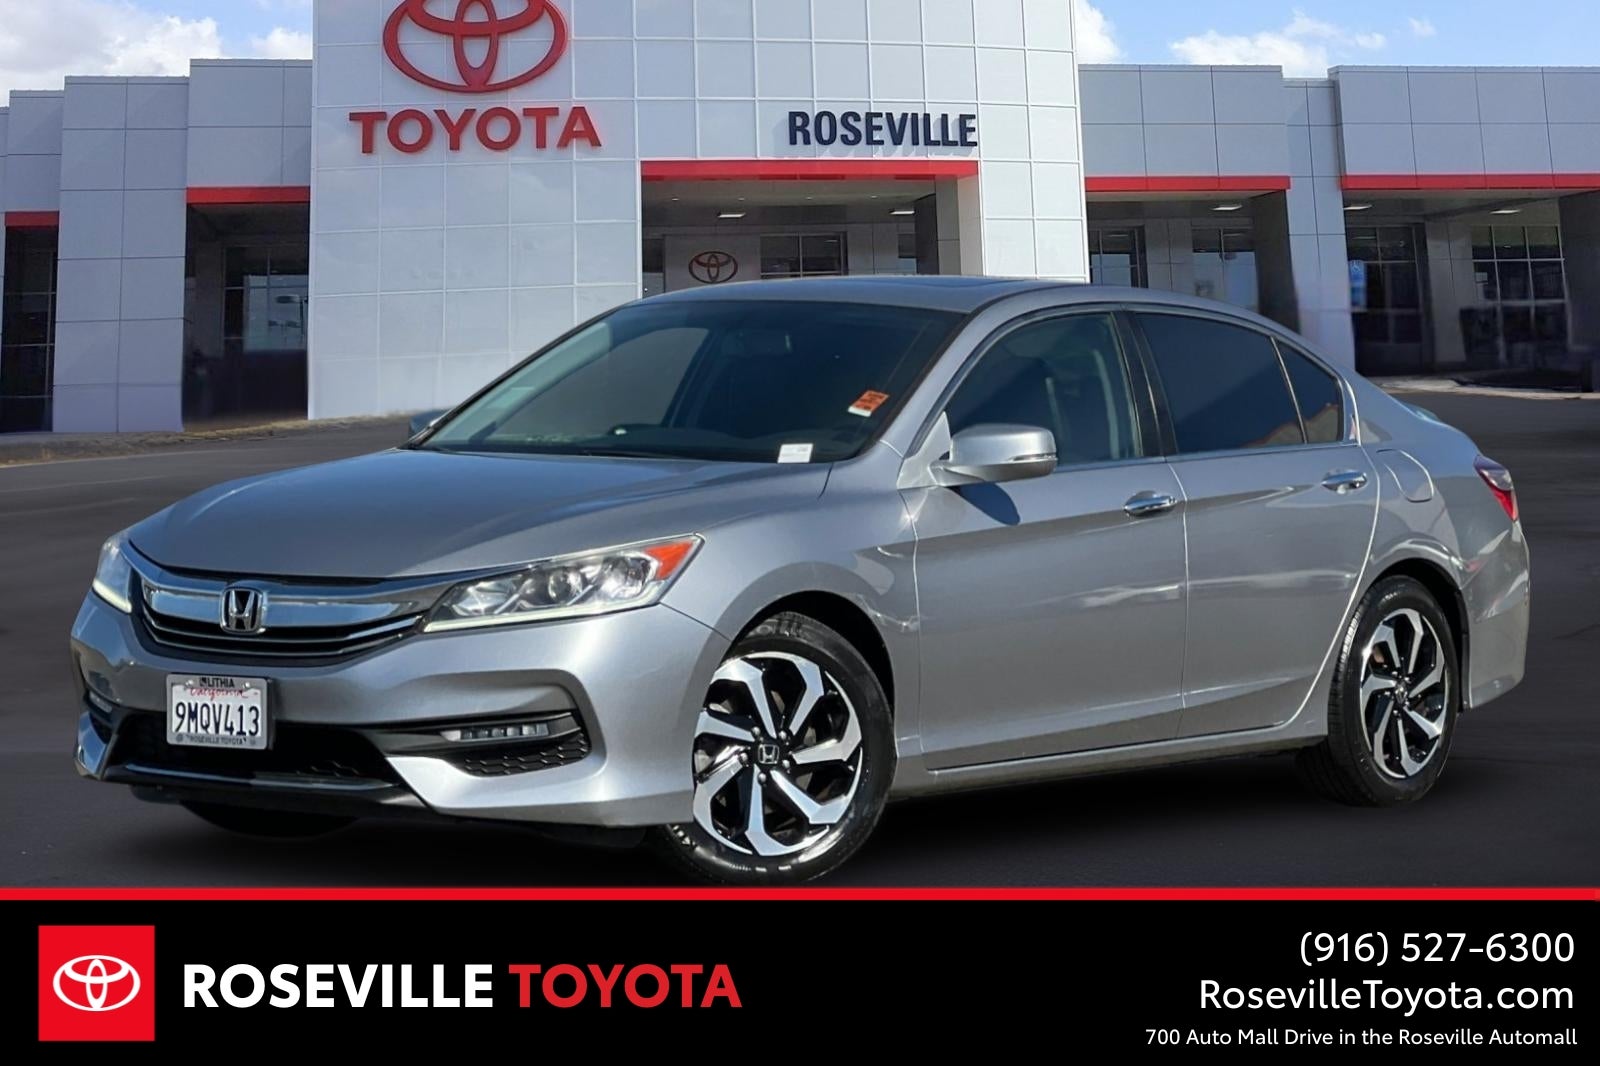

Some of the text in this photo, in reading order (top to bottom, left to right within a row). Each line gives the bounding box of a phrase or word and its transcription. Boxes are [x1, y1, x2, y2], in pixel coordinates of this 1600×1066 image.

[349, 106, 602, 154] TOYOTA
[788, 110, 978, 147] ROSEVILLE
[207, 677, 235, 689] LITHIA
[175, 701, 260, 737] 9MQV413
